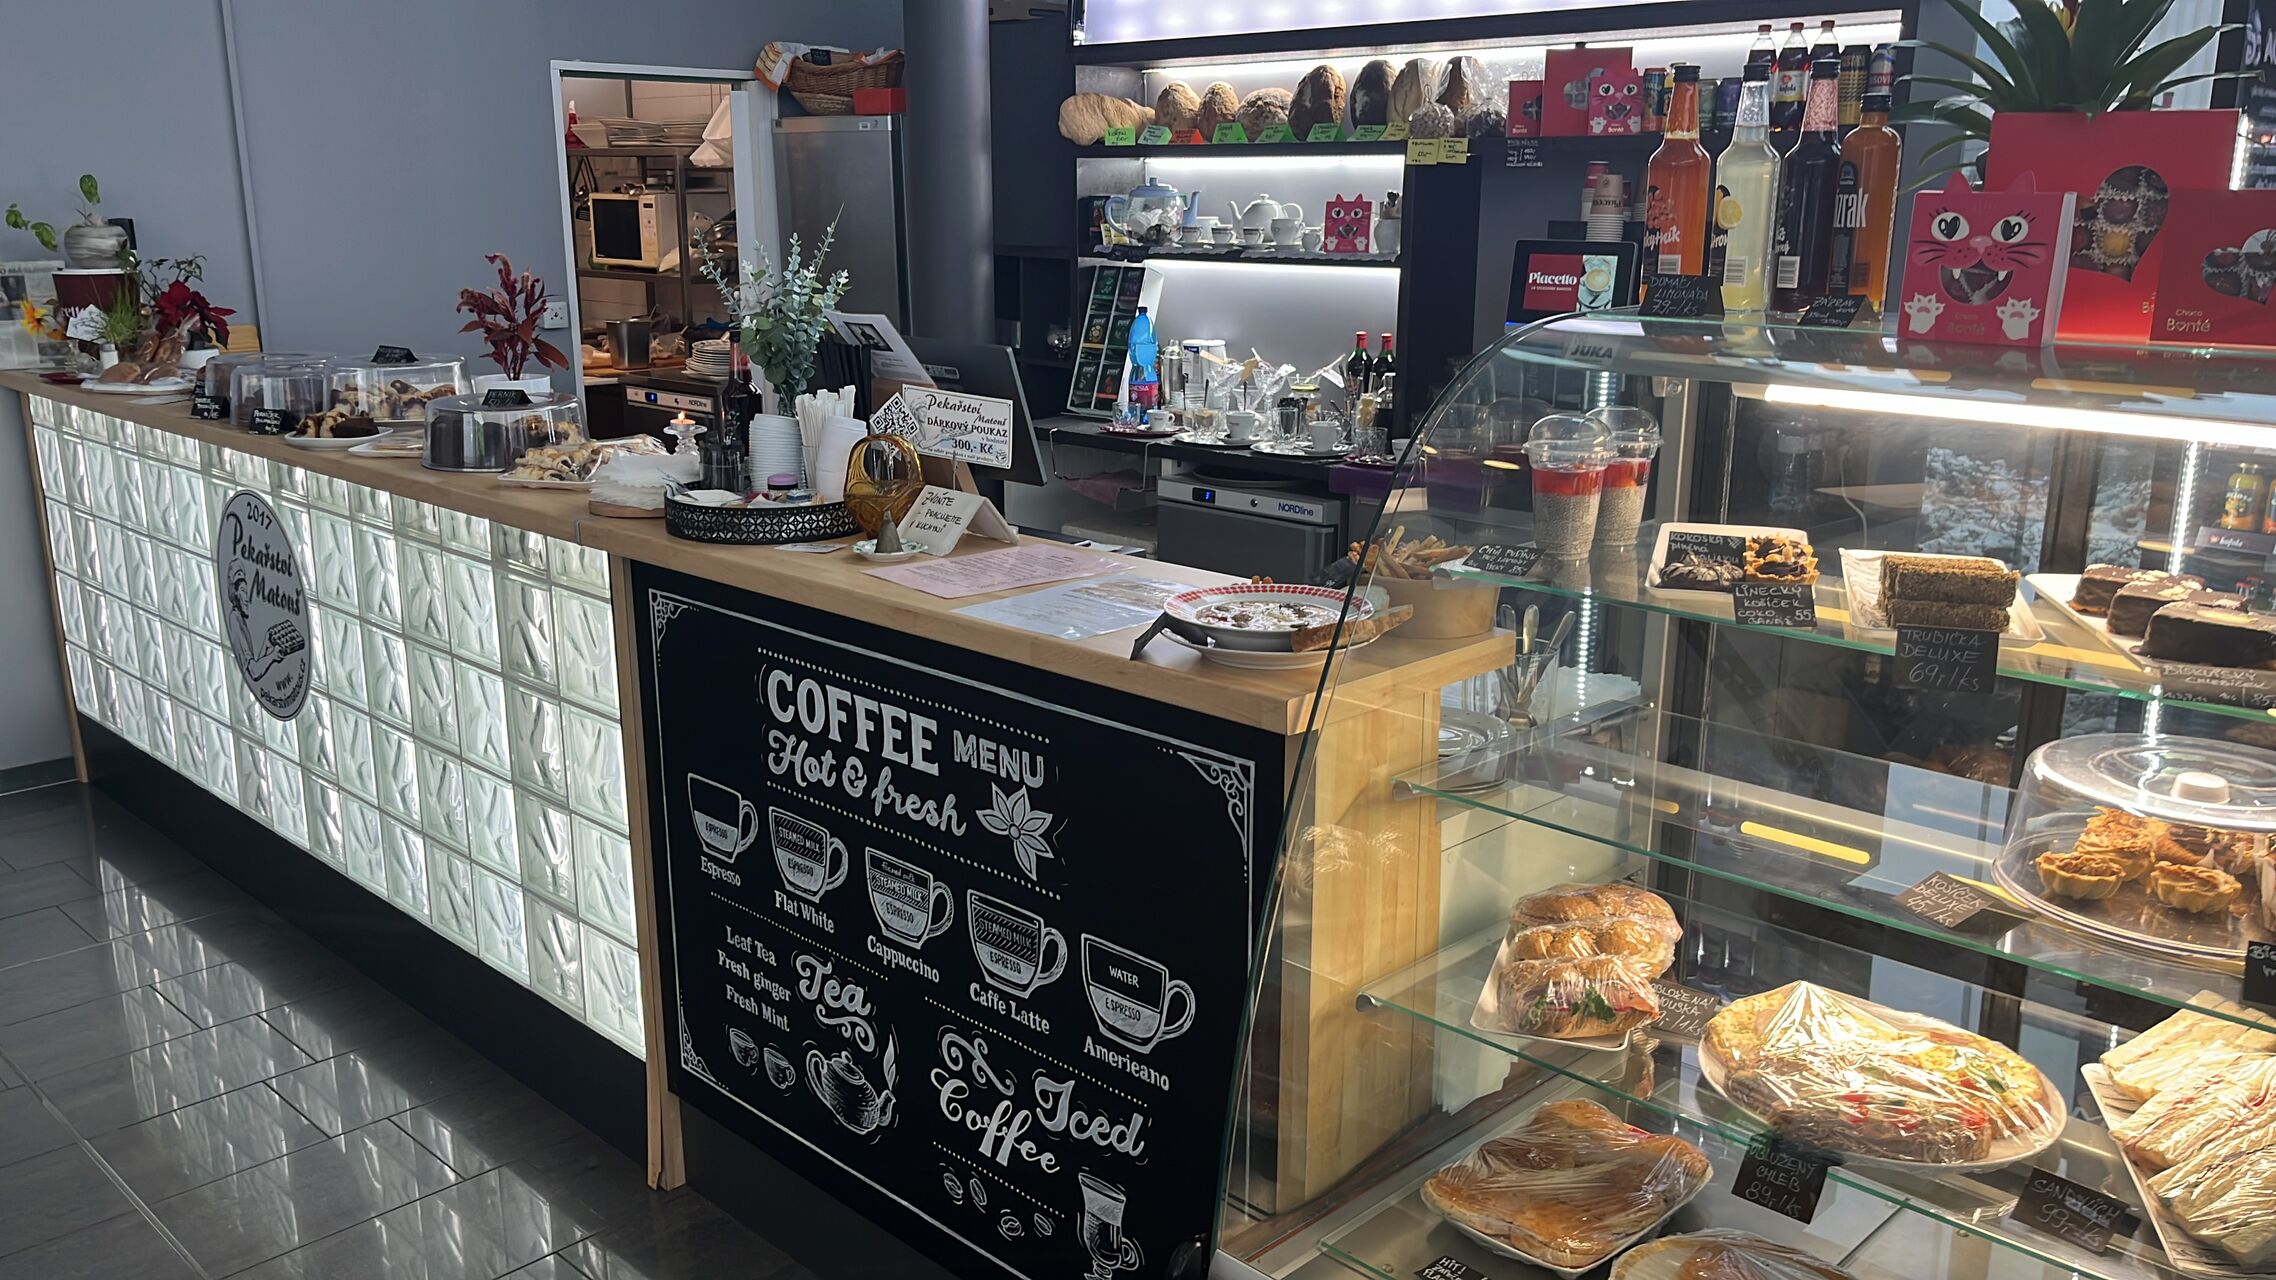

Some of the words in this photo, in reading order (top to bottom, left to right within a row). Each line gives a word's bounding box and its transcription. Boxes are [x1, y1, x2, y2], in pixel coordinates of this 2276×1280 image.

[1528, 271, 1578, 286] Piacetto
[2175, 308, 2203, 318] Choco
[1571, 344, 1614, 359] JUKA
[927, 416, 969, 432] DÁRKOVÝ
[971, 424, 1008, 438] POUKAZ
[974, 414, 1008, 426] Matouš
[980, 442, 994, 455] Kč
[247, 501, 273, 530] 2017
[249, 568, 302, 617] Matouš
[1900, 642, 1985, 664] DELUXE
[766, 668, 940, 777] COFFEE
[953, 729, 1045, 789] MENU
[767, 728, 837, 788] Hot
[842, 756, 868, 799] &
[871, 765, 968, 837] fresh
[778, 826, 805, 846] STEAMED
[805, 837, 821, 854] MILK
[700, 855, 741, 887] Espresso
[875, 873, 905, 896] STEAMED
[906, 883, 923, 904] MILK
[1912, 883, 1974, 914] DELUXE
[774, 890, 800, 918] Flat
[799, 901, 835, 934] White
[885, 902, 915, 924] ESPRESSO
[725, 925, 753, 954] Leaf
[754, 940, 777, 967] Tea
[978, 918, 1012, 942] STEAMED
[1012, 930, 1033, 949] MILK
[867, 934, 940, 984] Cappuccino
[989, 951, 1022, 975] ESPRESSO
[717, 948, 751, 981] Fresh
[753, 971, 792, 1002] ginger
[795, 954, 872, 1016] Tea
[1109, 965, 1140, 989] WATER
[725, 984, 759, 1016] Fresh
[761, 1002, 791, 1033] Mint
[969, 982, 1007, 1015] Caffe
[1009, 1000, 1050, 1035] Latte
[1105, 997, 1142, 1023] ESPRESSO
[1657, 996, 1703, 1017] OUSKA
[930, 1067, 1061, 1174] Coffee
[1034, 1075, 1145, 1157] Iced
